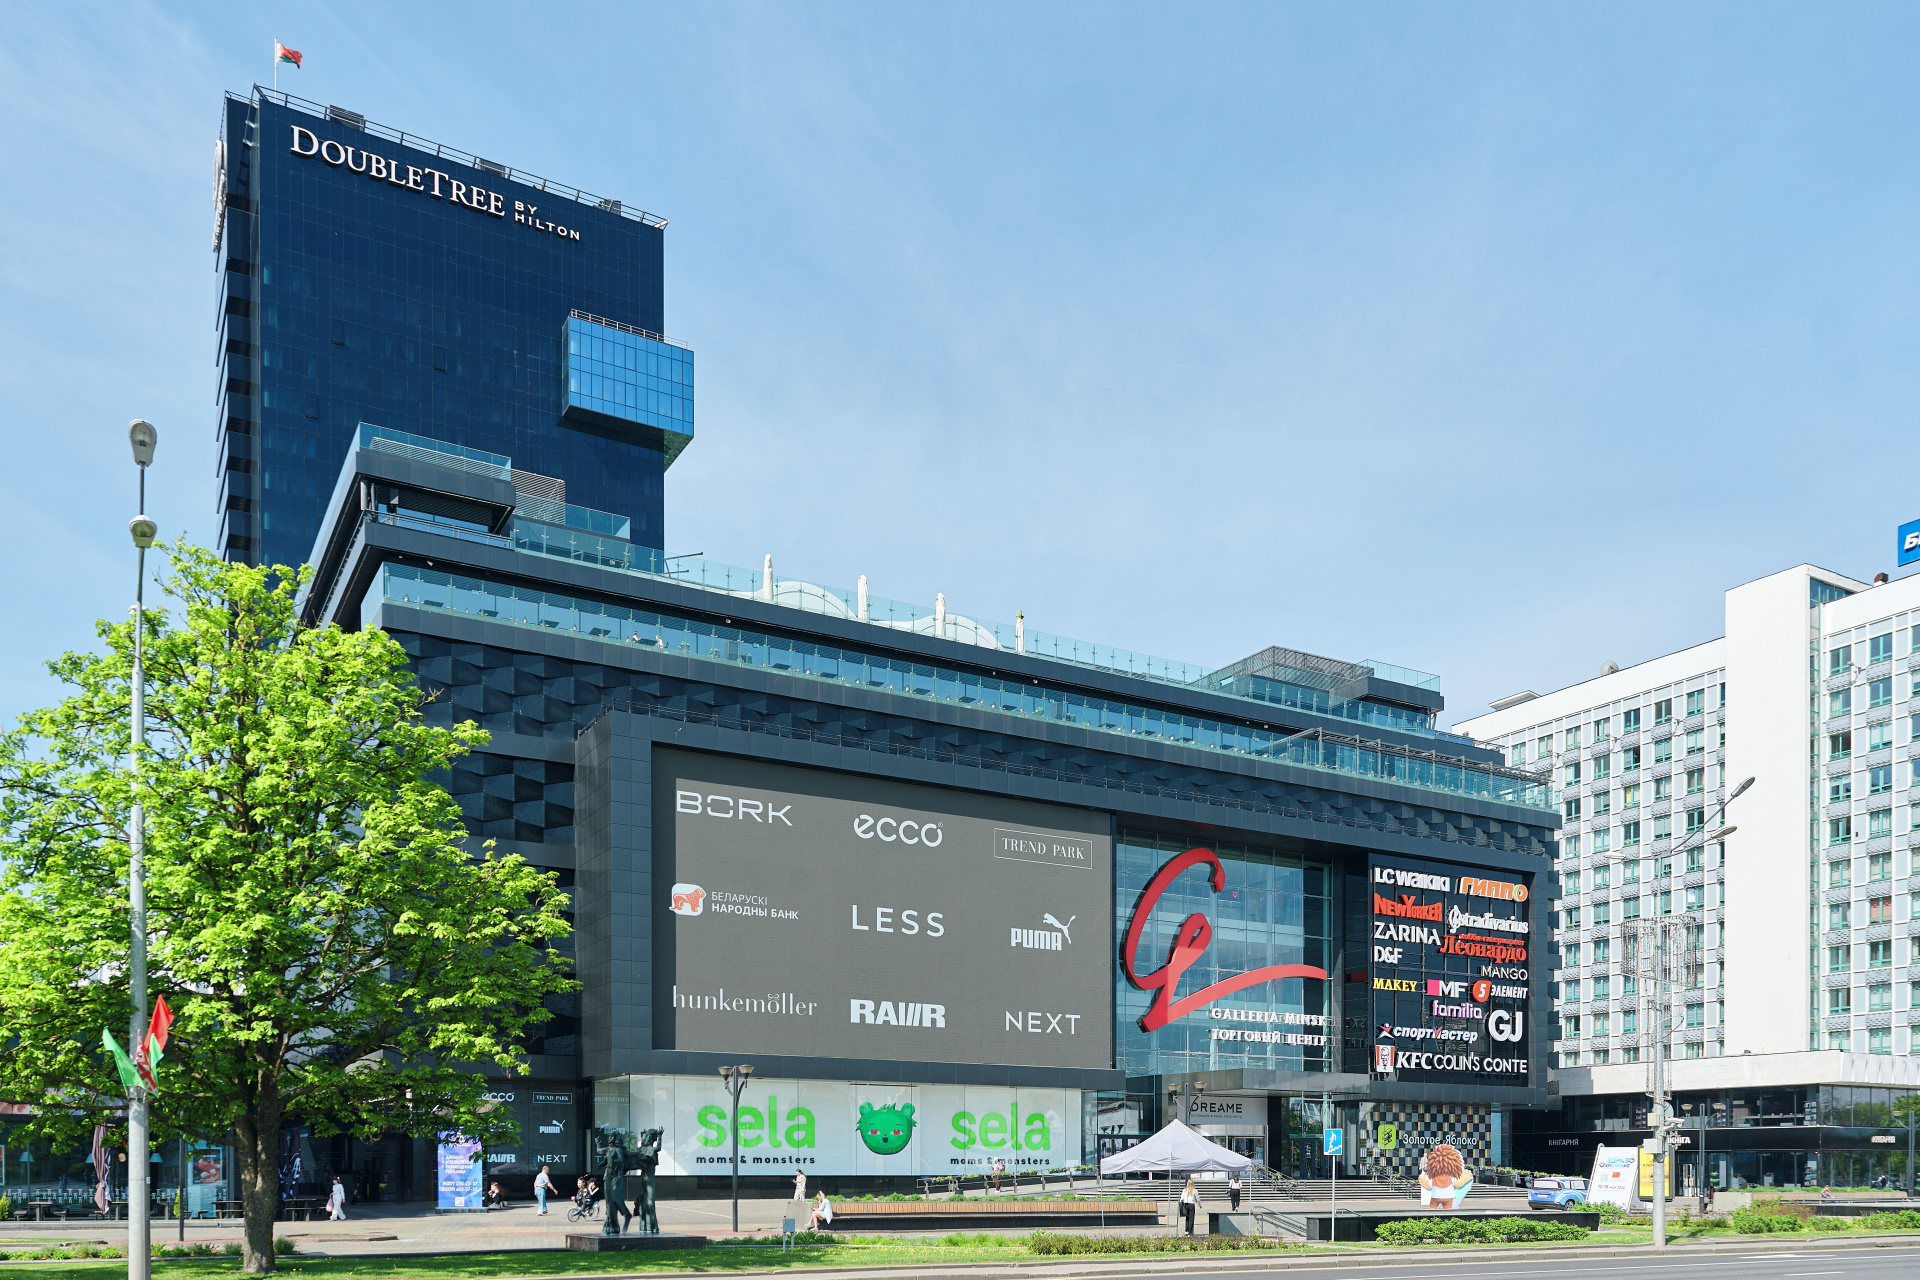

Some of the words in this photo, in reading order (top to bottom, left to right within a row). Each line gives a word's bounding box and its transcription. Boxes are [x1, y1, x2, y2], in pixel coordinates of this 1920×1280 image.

[514, 200, 538, 215] BY
[514, 212, 580, 241] HILTON
[676, 790, 794, 827] BORK
[853, 814, 943, 848] ecco
[1002, 836, 1047, 855] TREND
[1053, 842, 1085, 861] PARK
[1461, 876, 1528, 902] ГИППО
[711, 891, 768, 906] БЕЛАРУСКІ
[711, 902, 768, 917] НАРОДНЫ
[771, 908, 799, 920] БАНК
[852, 904, 945, 938] LESS
[1011, 927, 1062, 951] PUMA
[1374, 921, 1441, 945] ZARINA
[1440, 935, 1527, 964] Леонардо
[1482, 965, 1528, 980] MANGO
[1373, 977, 1418, 992] MAKEY
[1439, 981, 1468, 998] MF
[1478, 983, 1487, 998] 5
[1490, 984, 1528, 999] ЭЛЕМЕНТ
[1211, 1007, 1279, 1023] GALLERIA
[1284, 1012, 1326, 1026] MINSK
[1433, 1000, 1483, 1019] familia
[1005, 1009, 1081, 1035] NEXT
[1488, 1009, 1523, 1042] GJ
[1211, 1028, 1281, 1044] ТОРГОВЫЙ
[1286, 1034, 1327, 1046] ЦЕНТР
[1396, 1051, 1434, 1069] KFC
[1434, 1052, 1480, 1071] COLIN'S
[1483, 1057, 1528, 1074] CONTE
[1190, 1102, 1243, 1113] DREAME
[539, 1126, 561, 1134] PUMA
[696, 1095, 816, 1148] sela
[950, 1102, 1051, 1150] sela
[1402, 1133, 1441, 1145] Золотое
[1445, 1134, 1478, 1146] Яблоко
[537, 1154, 568, 1163] NEXT
[696, 1156, 734, 1164] moms
[740, 1155, 747, 1164] &
[753, 1155, 816, 1164] monsters
[950, 1157, 983, 1165] moms
